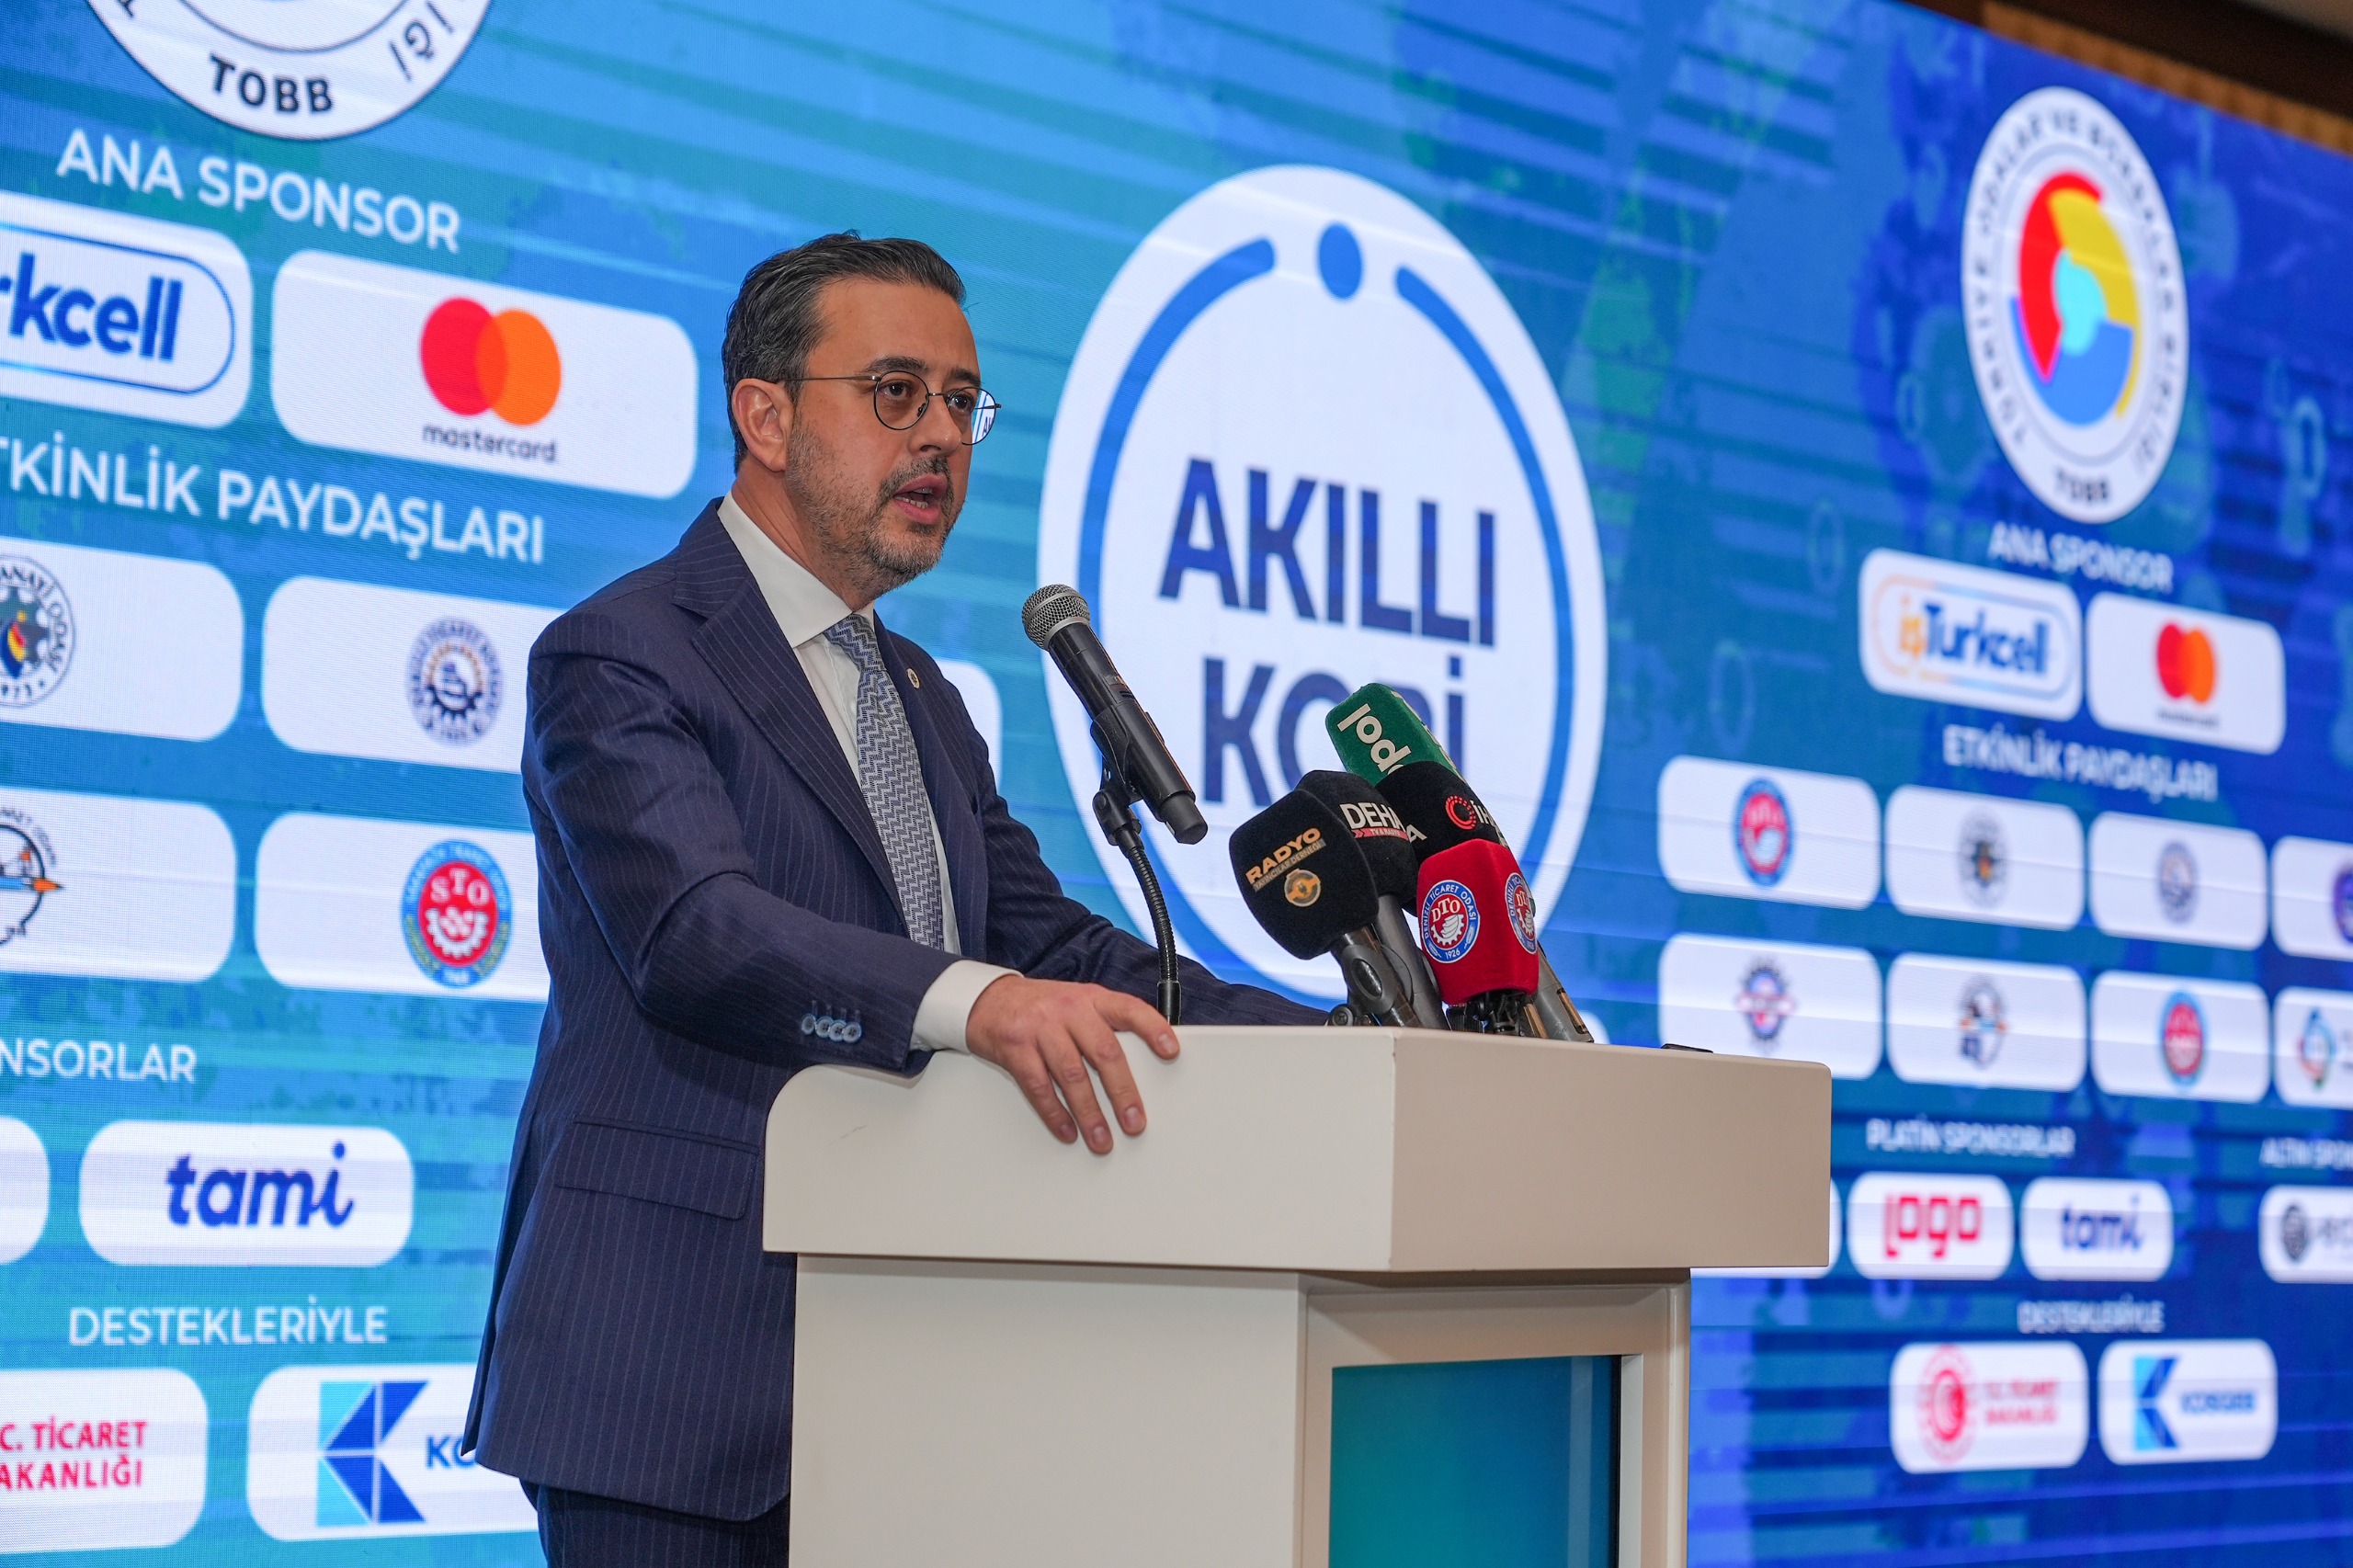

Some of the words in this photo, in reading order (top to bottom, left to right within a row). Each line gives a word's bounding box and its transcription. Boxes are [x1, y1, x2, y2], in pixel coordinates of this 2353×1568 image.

[210, 52, 334, 115] TOBB
[56, 128, 183, 200] ANA
[198, 157, 461, 254] SPONSOR
[0, 251, 184, 363] kcell
[422, 422, 557, 462] mastercard
[218, 467, 544, 562] PAYDAŞLARI
[1157, 456, 1497, 648] AKILLI
[1986, 520, 2050, 570] ANA
[2049, 531, 2174, 593] SPONSOR
[1941, 722, 2063, 780] ETKİNLİK
[2063, 741, 2219, 804] PAYDAŞLARI
[1339, 801, 1406, 833] DEHA
[1245, 827, 1323, 885] RADYO
[429, 867, 490, 907] STO
[1431, 897, 1461, 923] DTO
[1461, 891, 1477, 921] ODASI
[1445, 948, 1461, 960] 1926
[0, 1037, 198, 1084] NSORLAR
[1941, 1120, 2076, 1159] SPONSORLAR
[165, 1140, 355, 1229] tami
[69, 1295, 388, 1346] DESTEKLERİYLE
[31, 1415, 148, 1451] TİCARET
